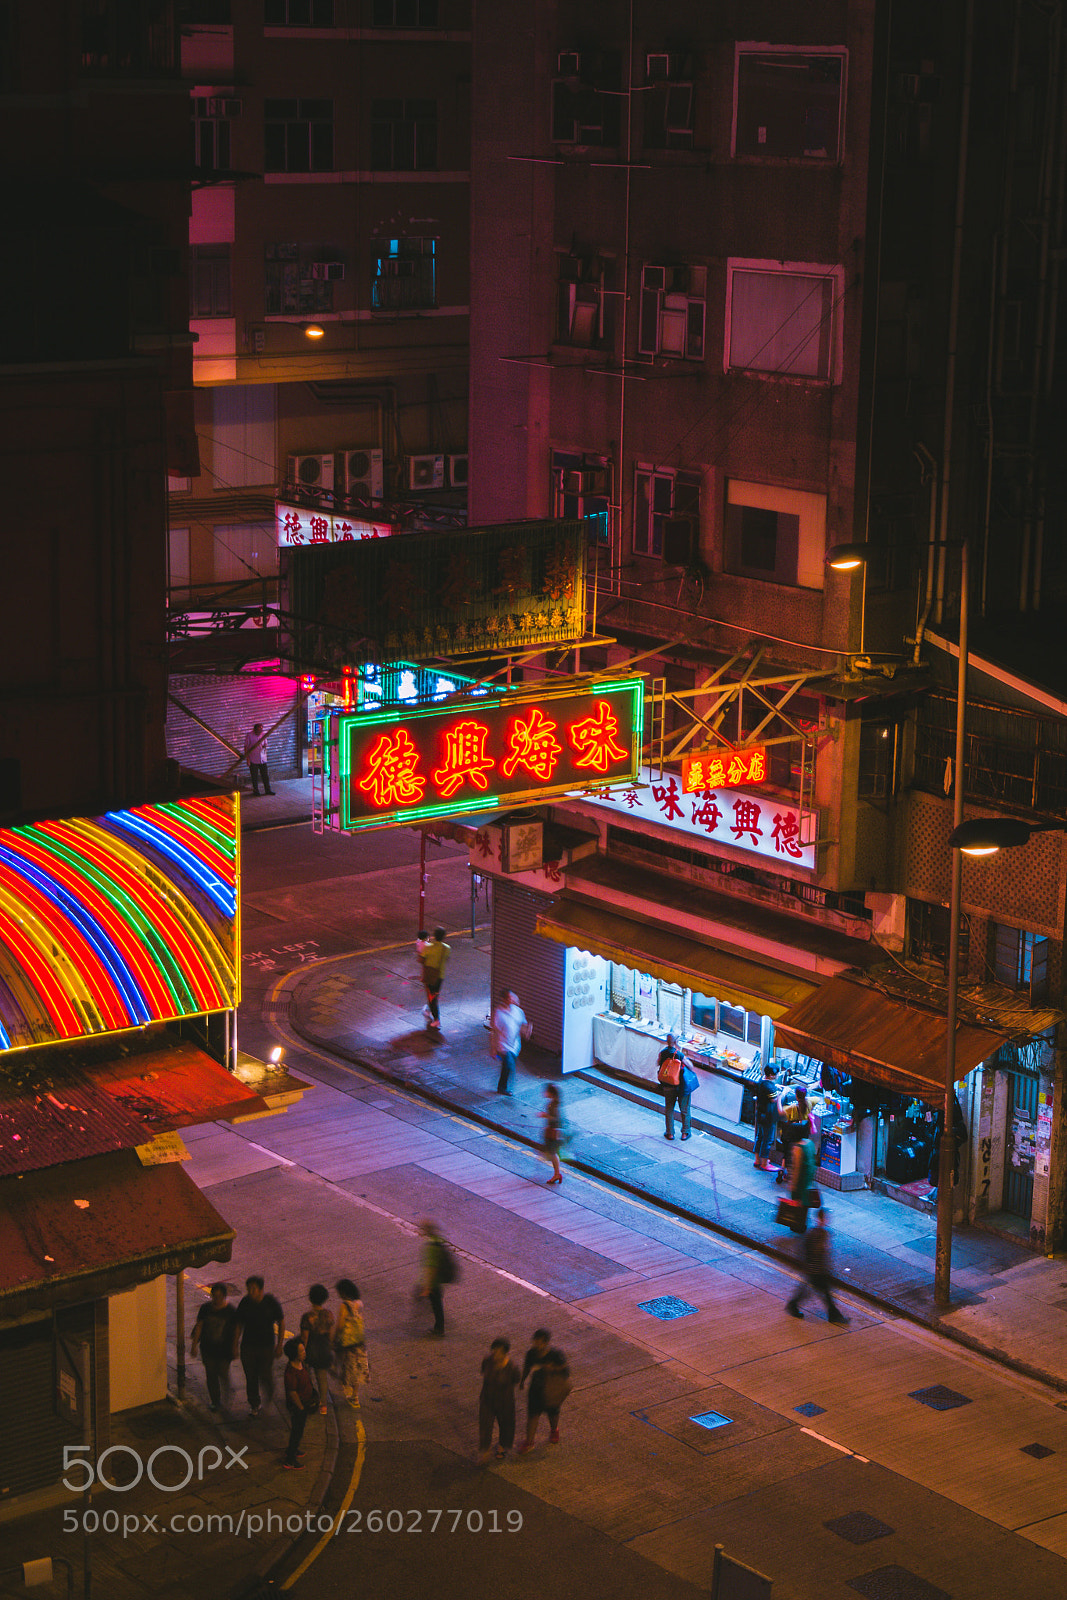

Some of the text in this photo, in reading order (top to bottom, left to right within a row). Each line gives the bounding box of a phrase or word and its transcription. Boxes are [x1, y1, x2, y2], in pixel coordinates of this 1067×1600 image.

[360, 702, 628, 804] 德興海味
[241, 940, 320, 961] OK LEFT
